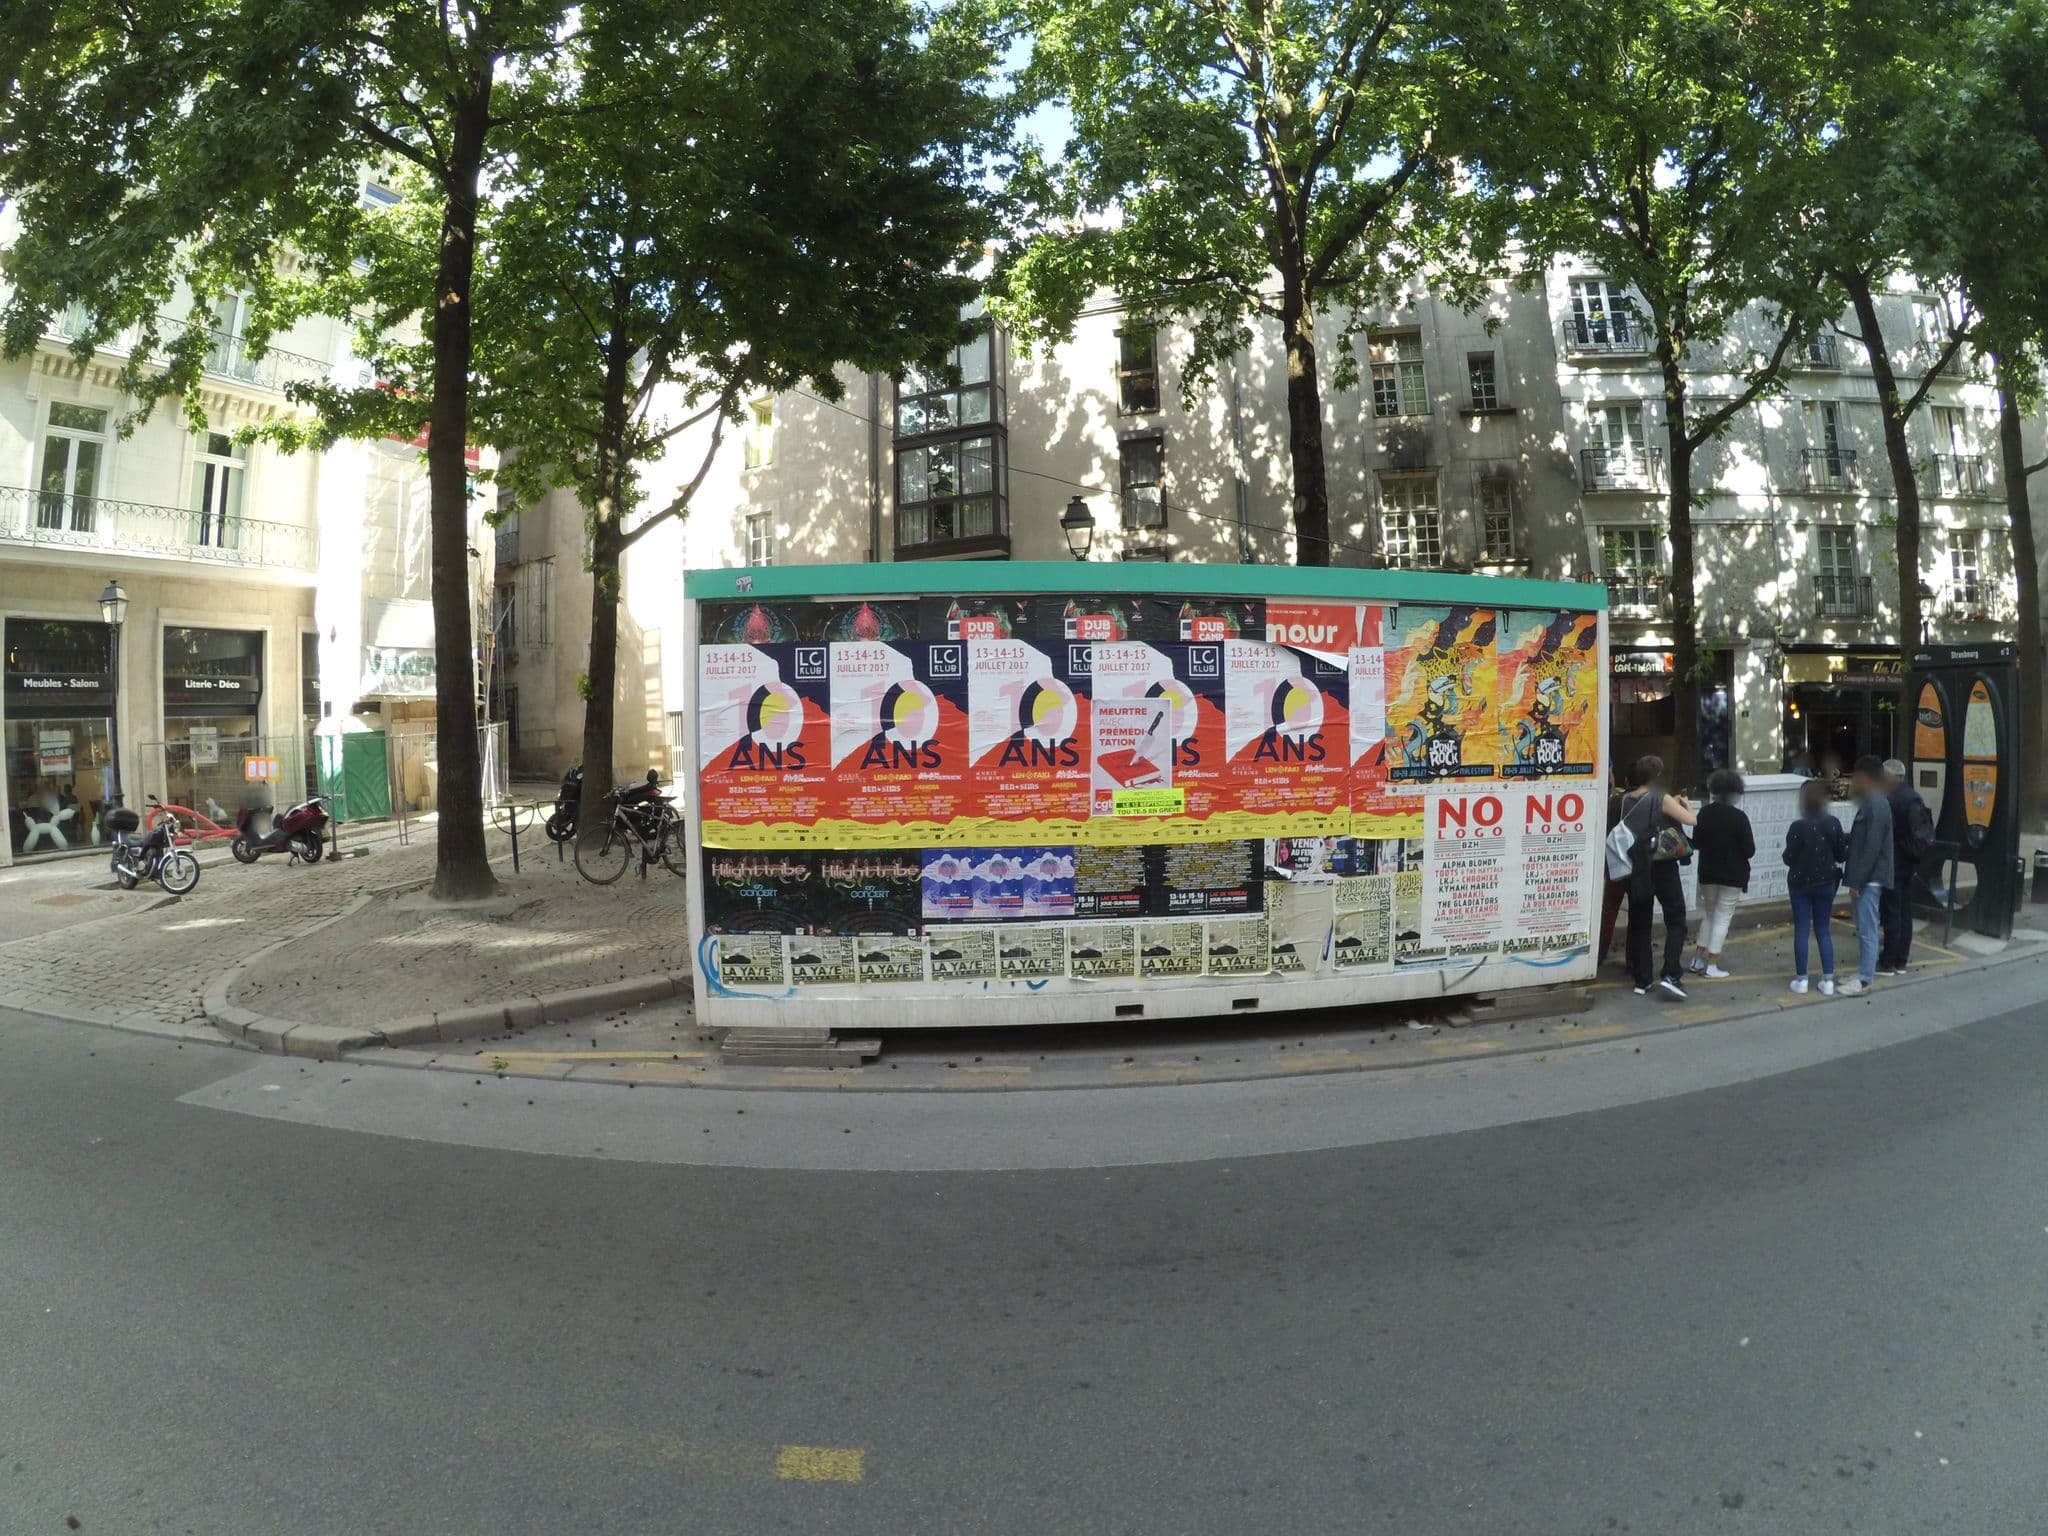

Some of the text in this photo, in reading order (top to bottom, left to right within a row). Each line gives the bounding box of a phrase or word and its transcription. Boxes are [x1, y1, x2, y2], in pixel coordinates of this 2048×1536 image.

[967, 622, 994, 632] DUB
[1085, 620, 1110, 631] DUB
[1199, 621, 1224, 631] DUB
[1951, 650, 1978, 659] Strasbourg
[705, 665, 757, 675] JUILLET 2017
[836, 663, 890, 674] JUILLET 2017
[975, 661, 1029, 671] JUILLET 2017
[1098, 662, 1151, 672] JUILLET 2017
[1231, 660, 1280, 669] JUILLET 2017
[23, 678, 62, 688] Meubles
[70, 678, 99, 688] Salons
[185, 679, 212, 689] Literie
[219, 679, 240, 689] Déco
[1099, 708, 1147, 716] MEURTRE
[1099, 738, 1136, 746] TATION
[999, 738, 1080, 768] ANS
[1254, 734, 1326, 762] ANS
[728, 741, 806, 771] ANS
[860, 739, 942, 770] ANS
[1430, 752, 1459, 766] ROCK
[1537, 750, 1562, 764] ROCK
[1438, 795, 1503, 828] NO
[1525, 793, 1585, 824] NO
[1438, 827, 1503, 840] LOGO
[1525, 823, 1583, 835] LOGO
